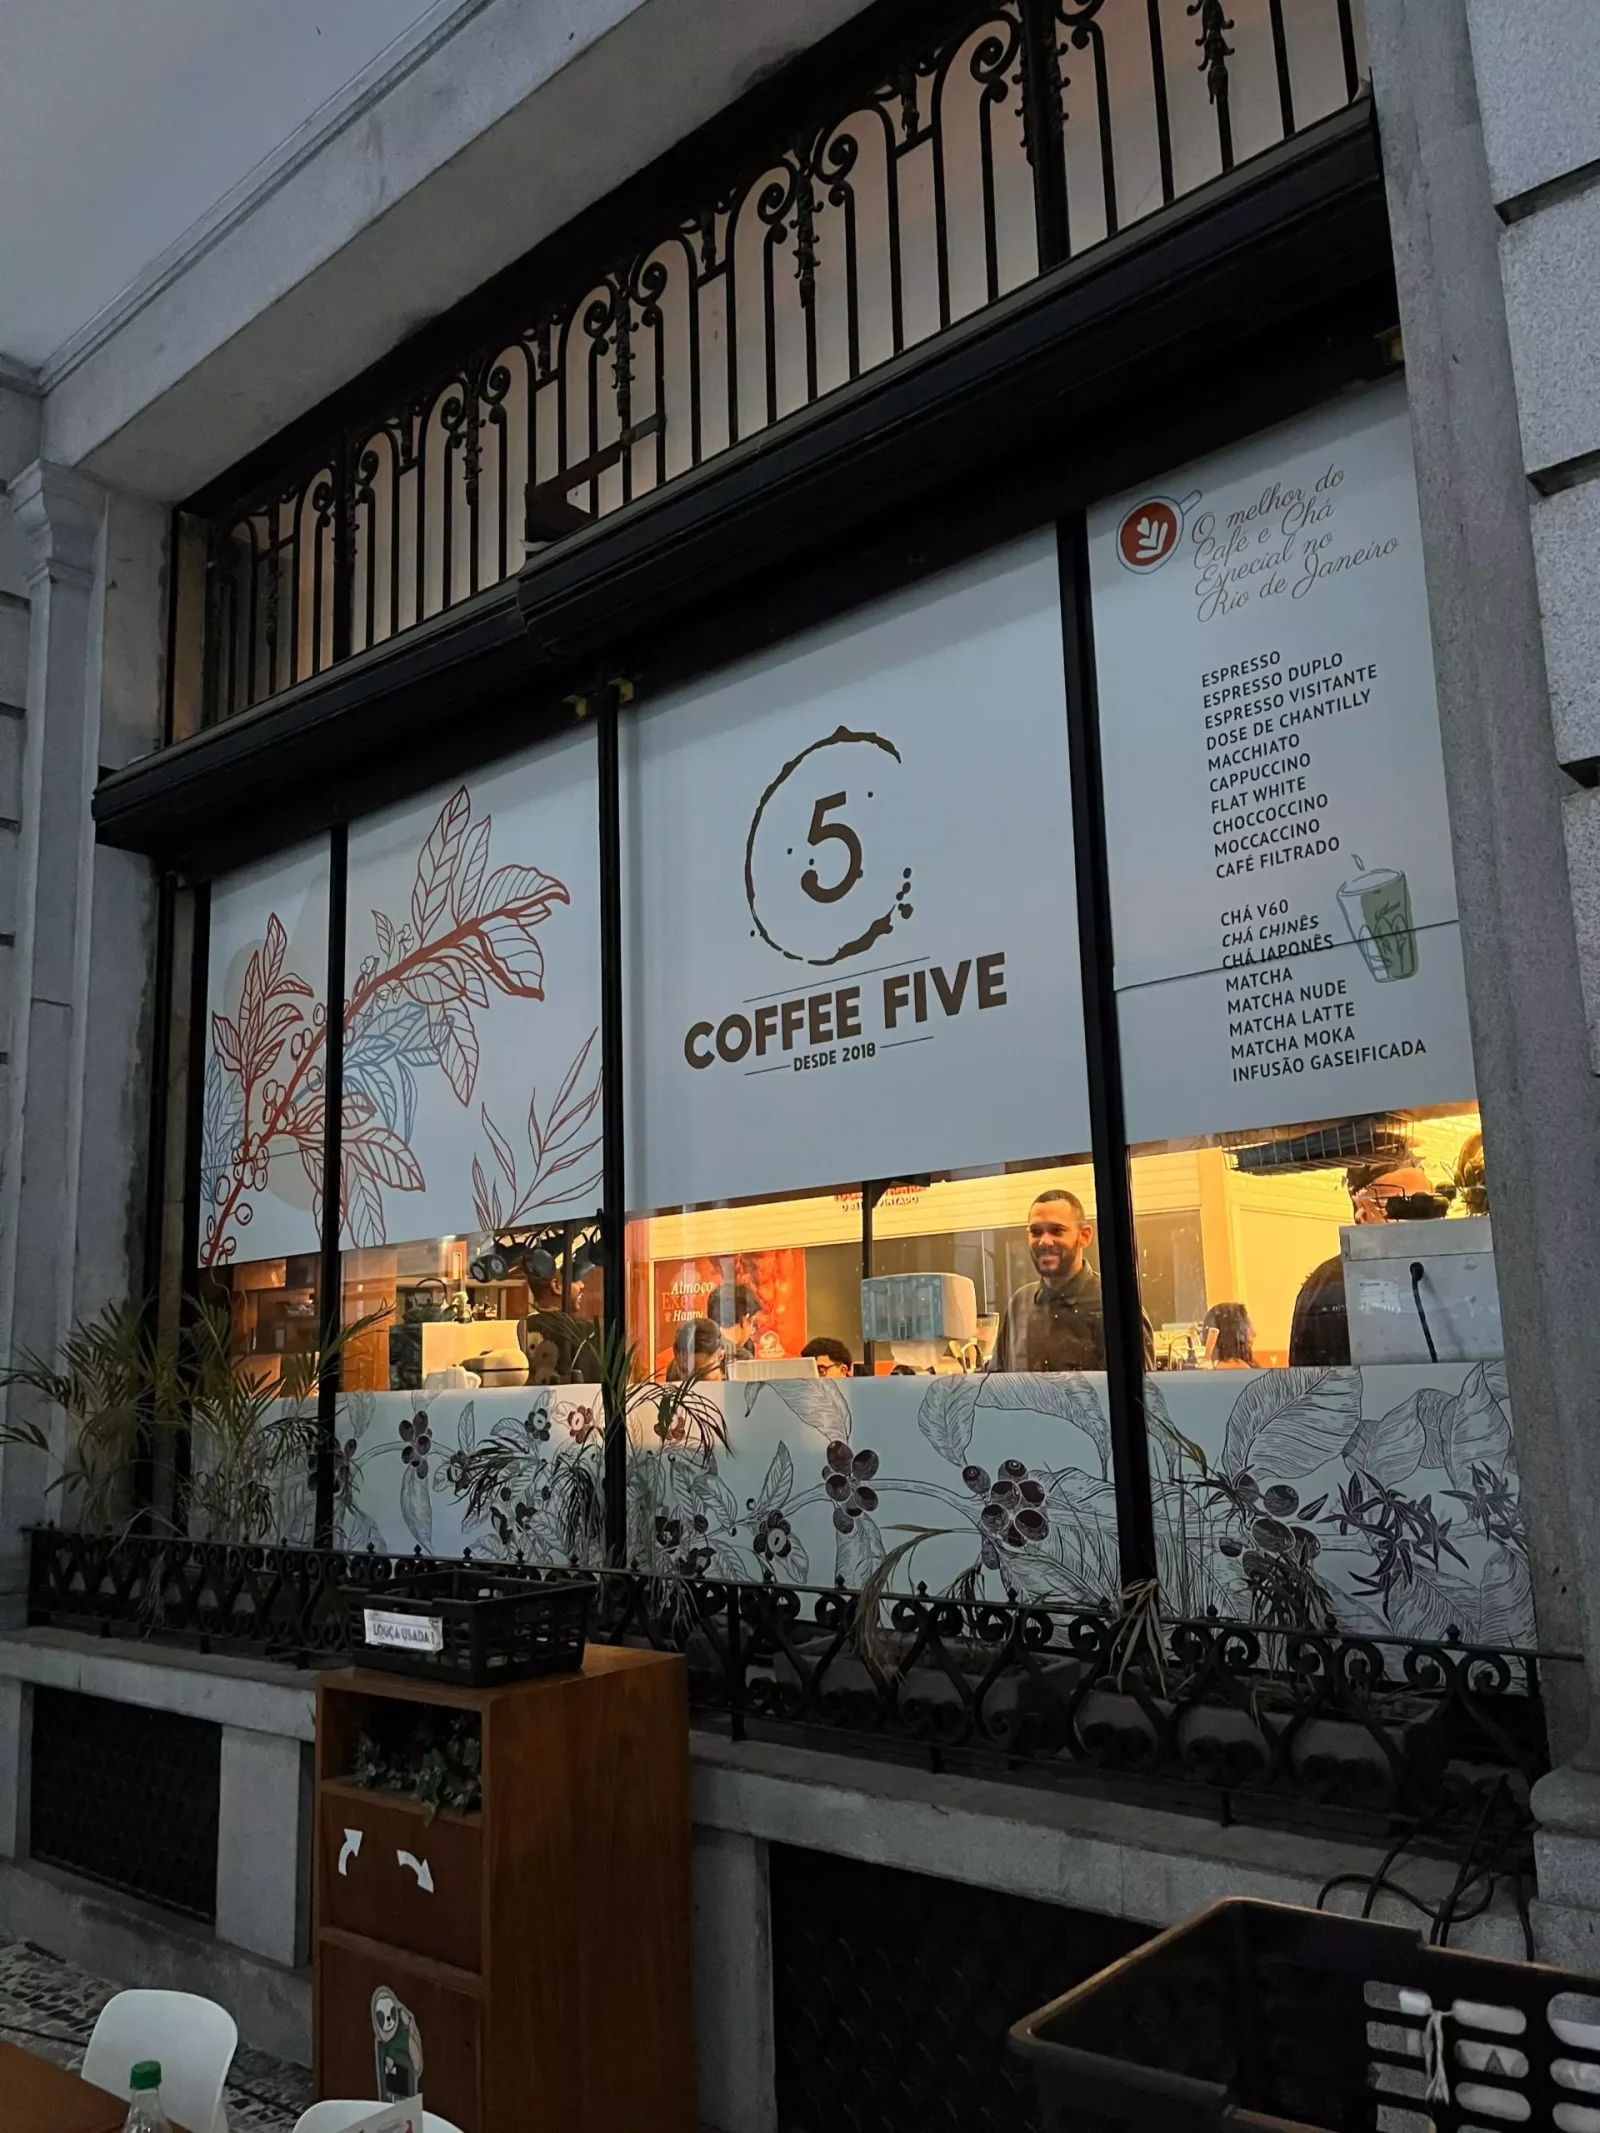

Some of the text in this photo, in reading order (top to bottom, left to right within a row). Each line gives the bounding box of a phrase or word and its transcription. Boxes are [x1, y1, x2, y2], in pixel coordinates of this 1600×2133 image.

[1192, 463, 1345, 545] O melhor do
[1193, 497, 1335, 570] Café e Chá
[1195, 531, 1333, 596] Especial no
[1197, 535, 1399, 623] Rio de Janeiro
[1202, 651, 1281, 688] ESPRESSO
[1203, 653, 1343, 708] ESPRESSO DUPLO
[1205, 664, 1378, 729] ESPRESSO VISITANTE
[1207, 689, 1371, 750] DOSE DE CHANTILLY
[1208, 734, 1300, 772] MACCHIATO
[1210, 753, 1310, 792] CAPPUCCINO
[1211, 776, 1306, 814] FLAT WHITE
[1213, 794, 1328, 835] CHOCCOCCINO
[800, 790, 863, 904] 5
[1215, 819, 1320, 858] MOCCACCINO
[1216, 837, 1340, 879] CAFÉ FILTRADO
[1221, 899, 1289, 926] CHÁ V60
[1222, 915, 1319, 947] CHÁ CHINÊS
[1223, 935, 1334, 969] CHÁ JAPONÊS
[1226, 967, 1293, 992] MATCHA
[1228, 980, 1347, 1015] MATCHA NUDE
[684, 951, 1008, 1070] COFFEE FIVE
[1229, 1002, 1355, 1037] MATCHA LATTE
[794, 1042, 876, 1072] DESDE 2018
[1231, 1026, 1355, 1059] MATCHA MOKA
[1233, 1039, 1427, 1082] INFUSÃO GASEIFICADA
[671, 1280, 714, 1295] Almoço
[373, 1623, 400, 1641] LOUÇA
